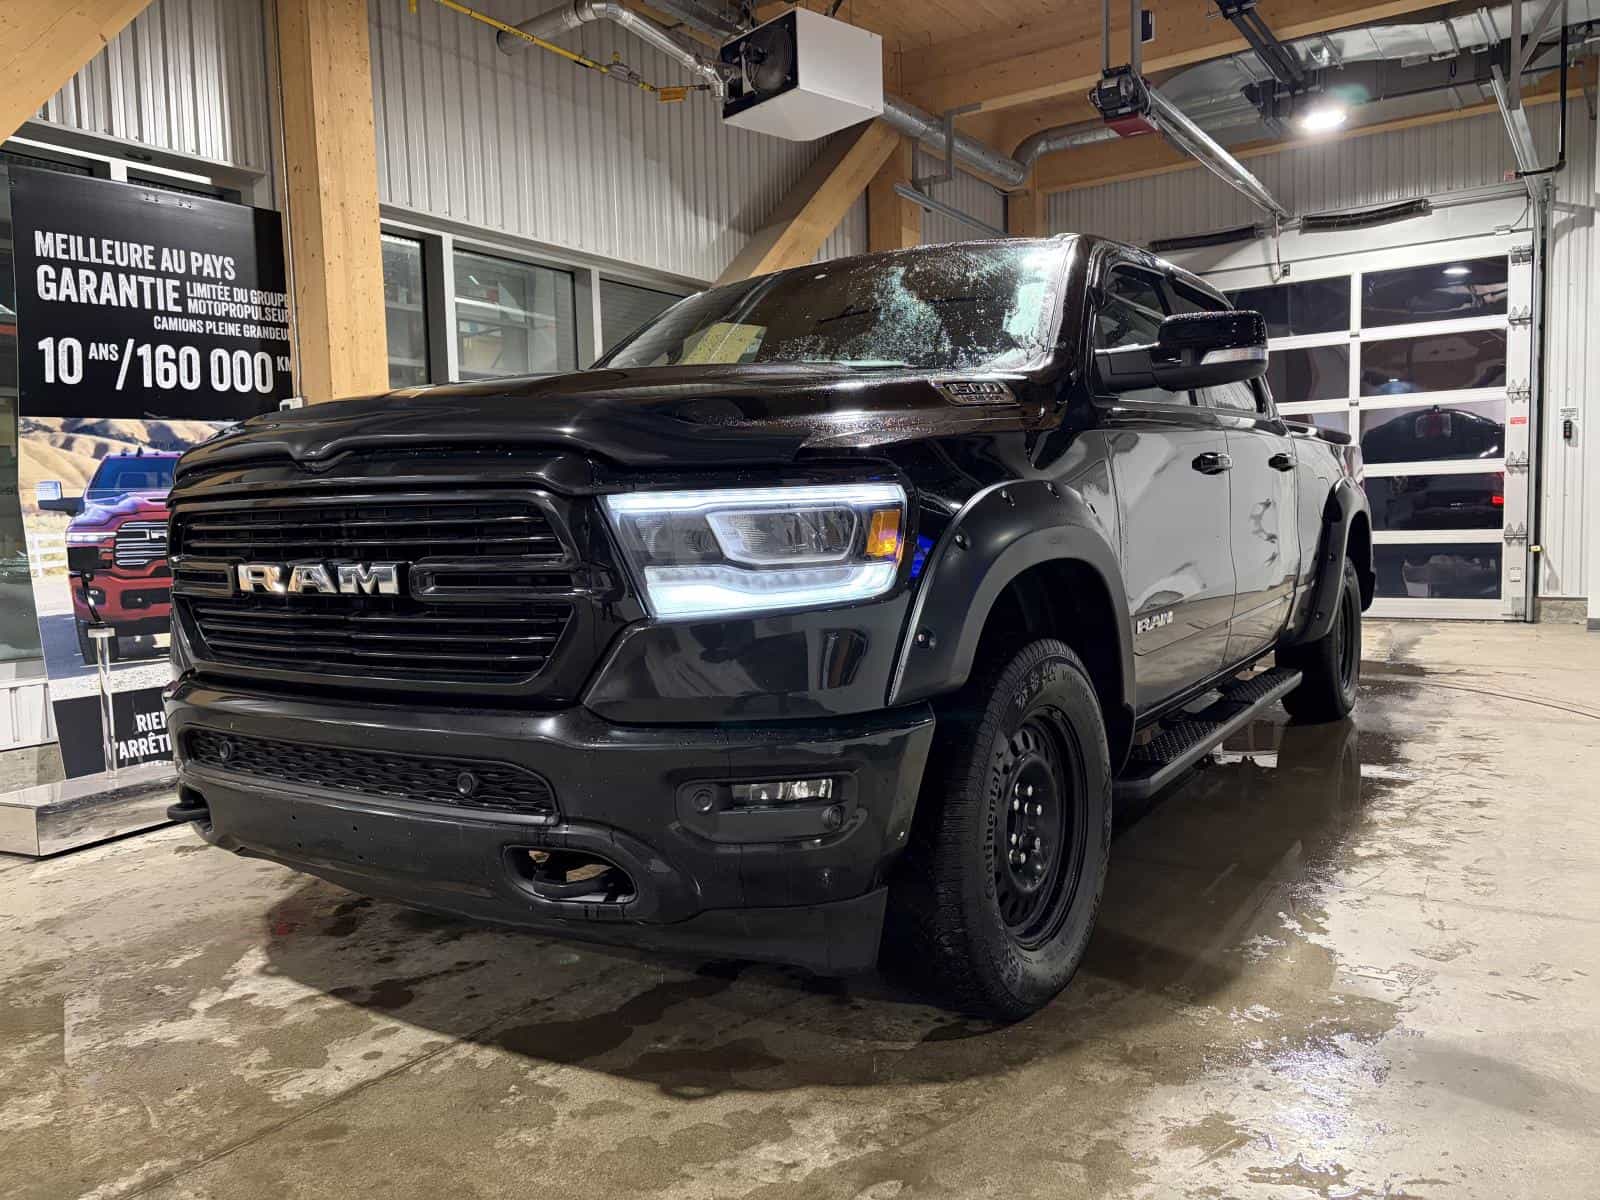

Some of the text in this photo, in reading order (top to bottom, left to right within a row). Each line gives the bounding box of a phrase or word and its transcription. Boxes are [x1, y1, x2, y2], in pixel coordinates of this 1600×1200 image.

[34, 230, 236, 281] MEILLEURE AU PAYS
[36, 264, 182, 312] GARANTIE
[186, 281, 230, 301] LIMITÉE
[233, 288, 249, 303] DU
[153, 315, 290, 341] CAMIONS PLEINE GRANDEU
[37, 336, 83, 385] 10
[88, 342, 119, 361] ANS
[209, 348, 273, 393] 000
[238, 562, 399, 595] RAM
[1136, 610, 1173, 634] RAM
